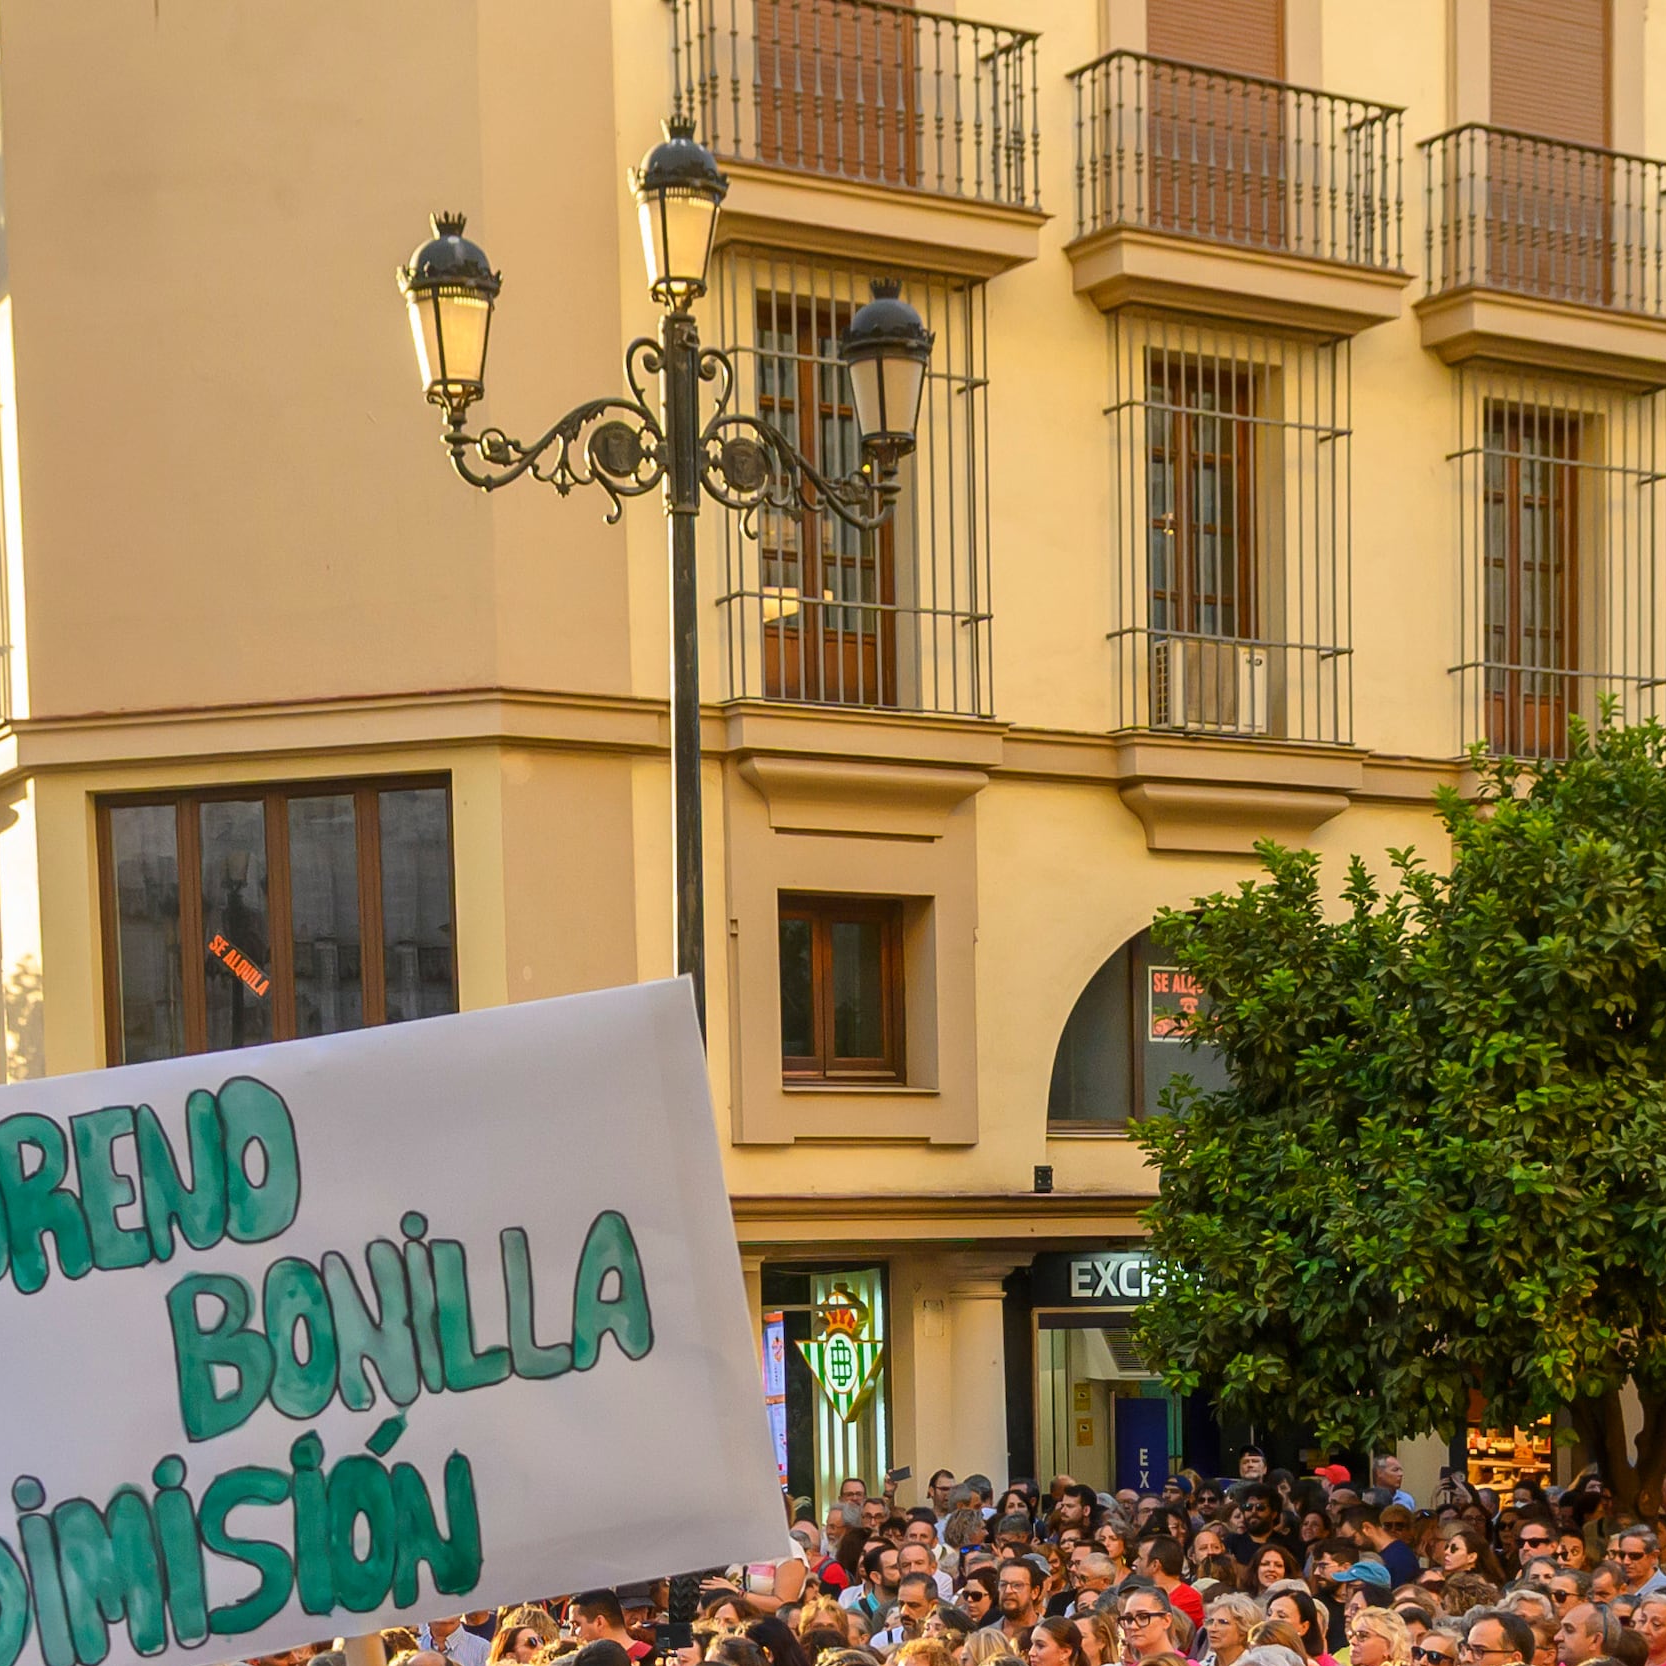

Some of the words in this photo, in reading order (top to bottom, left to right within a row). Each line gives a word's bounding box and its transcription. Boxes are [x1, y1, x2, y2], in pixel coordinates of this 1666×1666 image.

[208, 934, 230, 957] SE
[222, 948, 270, 996] ALQUILA
[1153, 972, 1169, 993] SE
[165, 1210, 655, 1443] BONILLA
